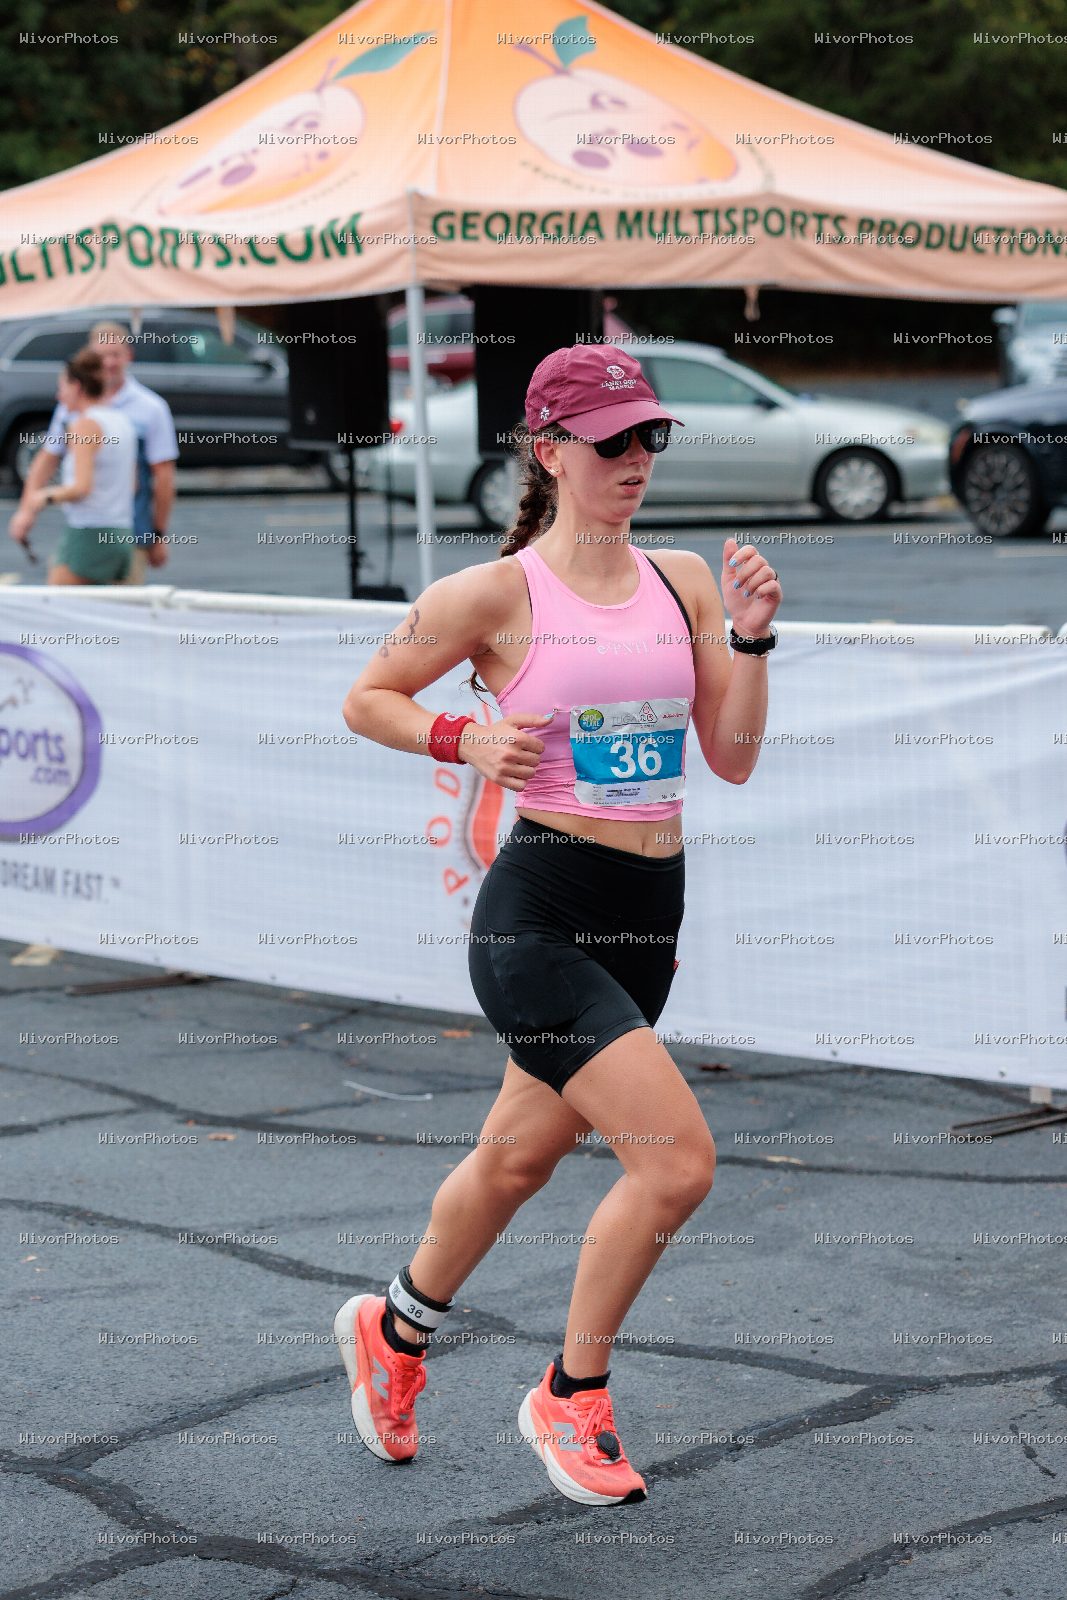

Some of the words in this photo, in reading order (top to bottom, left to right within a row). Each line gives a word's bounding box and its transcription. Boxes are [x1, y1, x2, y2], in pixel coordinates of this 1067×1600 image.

[431, 208, 605, 242] GEORGIA
[616, 206, 848, 242] MULTISPORTS
[856, 216, 1067, 257] PRODUCTION
[610, 739, 662, 779] 36
[407, 1304, 424, 1319] 36
